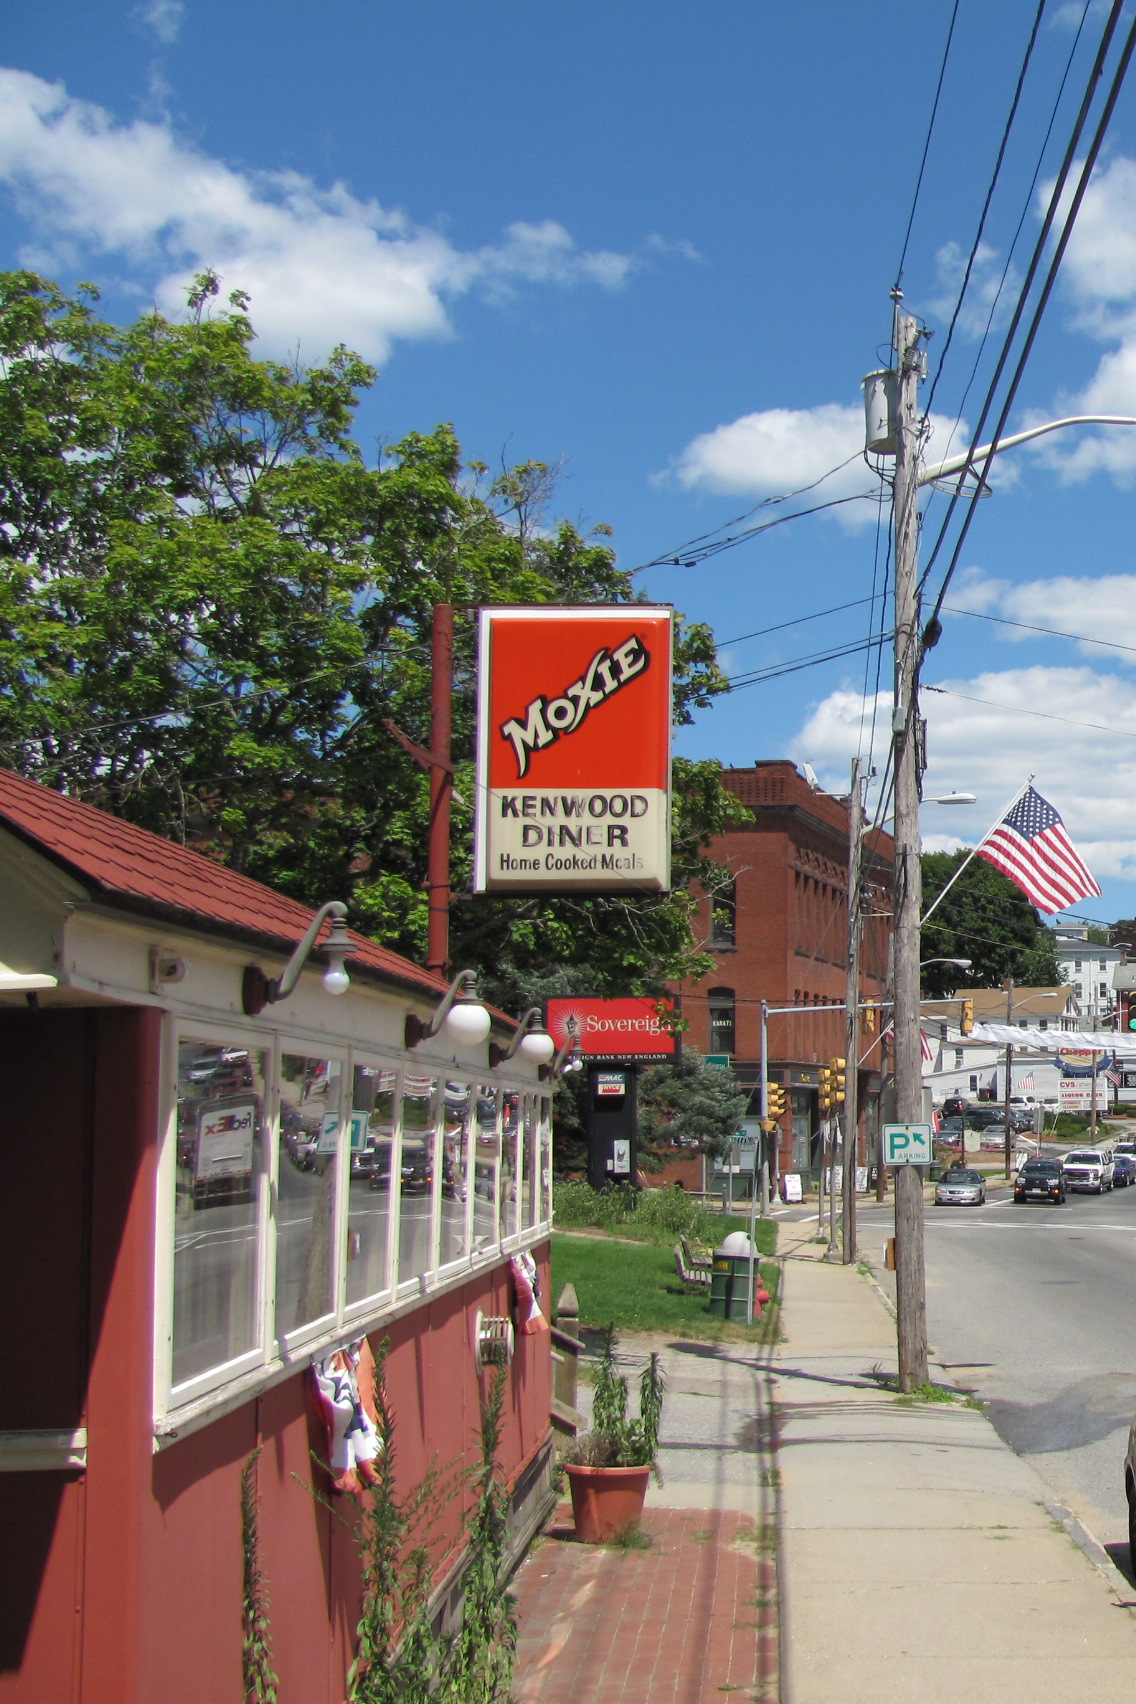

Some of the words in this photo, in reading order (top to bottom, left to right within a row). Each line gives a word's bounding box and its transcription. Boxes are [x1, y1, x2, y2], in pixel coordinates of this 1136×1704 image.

[500, 633, 650, 779] MOXIE
[501, 795, 649, 818] KENWOOD
[522, 824, 629, 848] DINER
[500, 854, 541, 871] Home
[545, 853, 598, 871] Cooked
[586, 1015, 672, 1036] Sovereign
